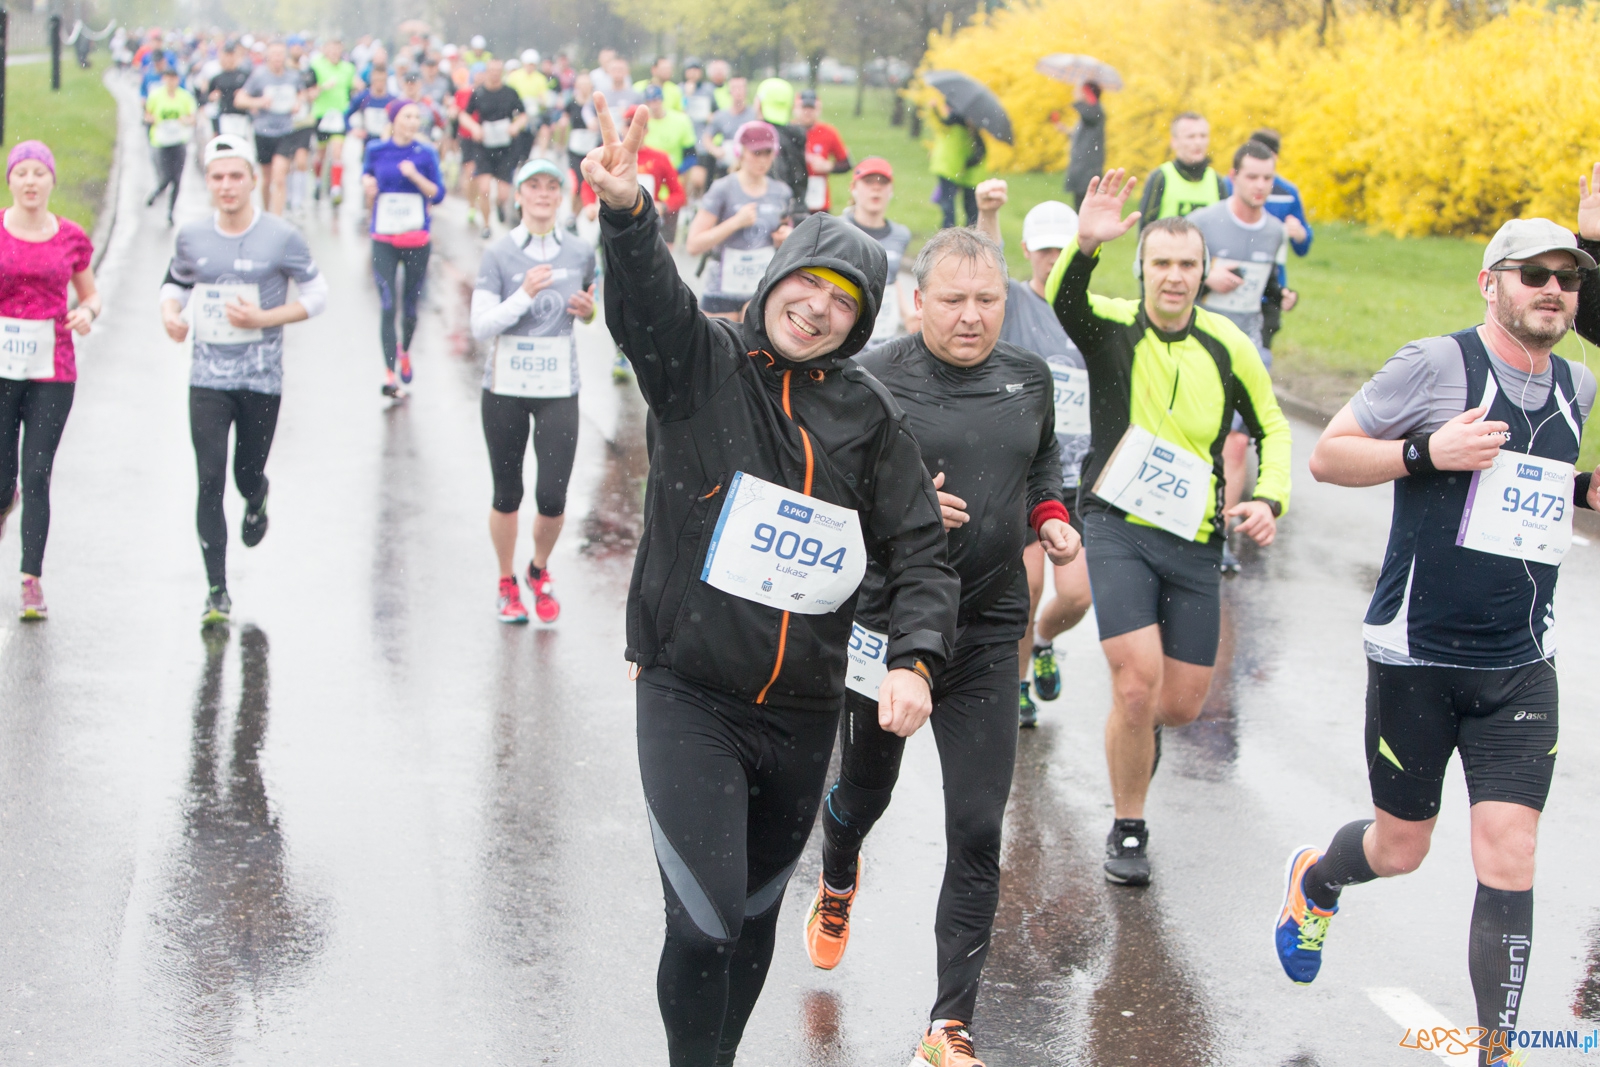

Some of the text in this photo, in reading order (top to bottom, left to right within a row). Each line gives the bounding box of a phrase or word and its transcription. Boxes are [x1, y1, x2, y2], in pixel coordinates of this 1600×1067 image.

[3, 338, 37, 356] 4119
[510, 355, 557, 372] 6638
[1138, 461, 1191, 499] 1726
[1502, 486, 1565, 522] 9473
[1521, 519, 1548, 531] Dariusz
[750, 522, 847, 574] 9094
[775, 562, 808, 579] Łukasz
[1499, 934, 1531, 1029] Kalenji
